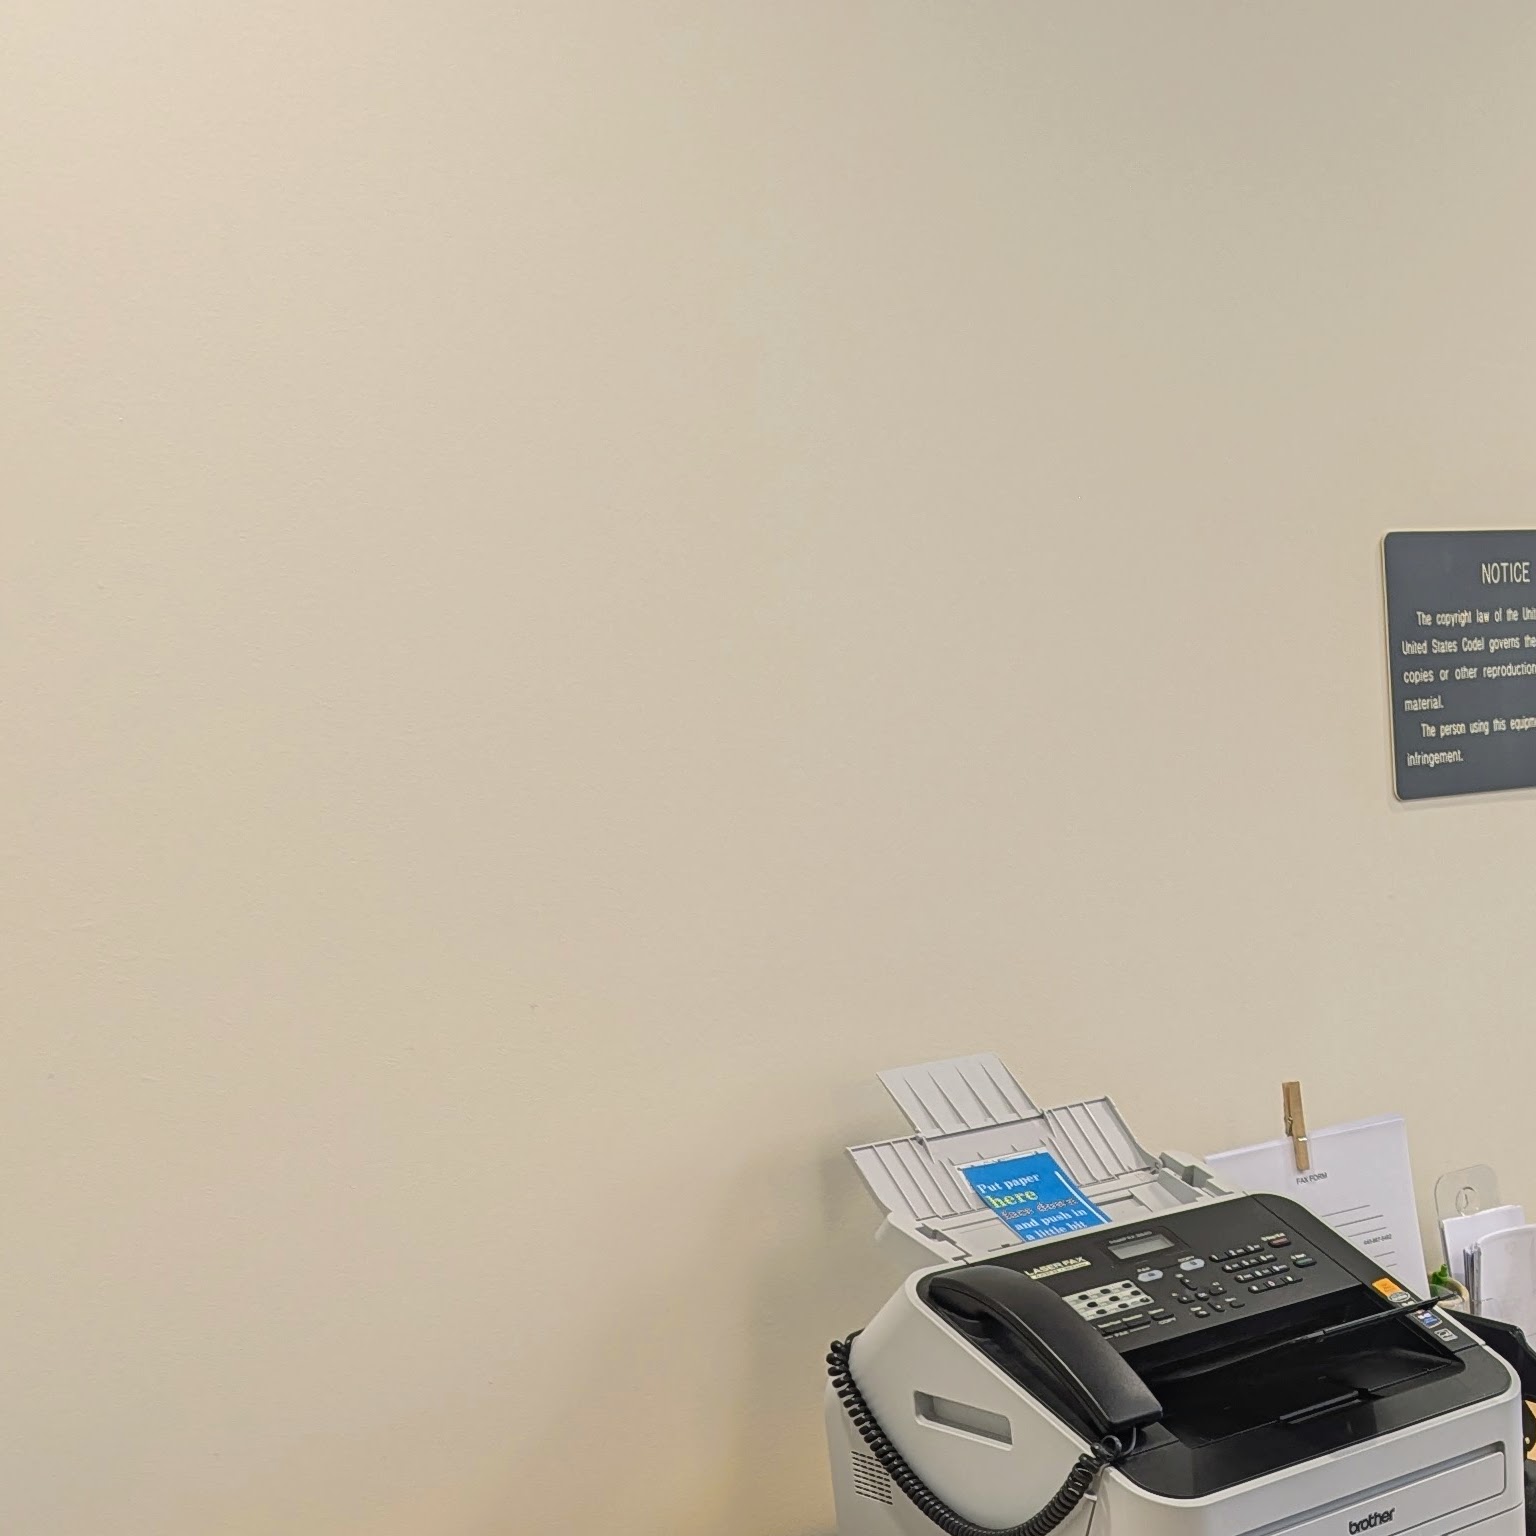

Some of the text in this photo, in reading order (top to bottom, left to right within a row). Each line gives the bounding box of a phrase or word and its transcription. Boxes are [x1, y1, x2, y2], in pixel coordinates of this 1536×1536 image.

[1481, 562, 1530, 584] NOTICE
[1416, 611, 1432, 626] The
[1436, 609, 1472, 627] copyright
[1476, 609, 1489, 623] law
[1494, 608, 1502, 622] of
[1506, 608, 1519, 621] the
[1401, 640, 1428, 655] United
[1431, 638, 1458, 654] States
[1489, 636, 1520, 653] governs
[1524, 635, 1536, 648] the
[1403, 669, 1434, 685] copies
[1439, 668, 1449, 681] or
[1454, 665, 1478, 681] other
[1404, 695, 1444, 712] material.
[1421, 722, 1436, 738] The
[1440, 722, 1466, 738] person
[1470, 719, 1489, 736] using
[1493, 717, 1506, 732] this
[1407, 749, 1464, 767] infringement.
[976, 1173, 1040, 1194] Put paper
[1296, 1172, 1328, 1185] FAX FORM
[985, 1190, 1039, 1208] here
[1014, 1208, 1088, 1231] and push in
[1025, 1234, 1036, 1242] a
[1035, 1225, 1068, 1239] little
[1024, 1262, 1065, 1276] LASER
[1061, 1256, 1086, 1267] FAX
[1349, 1507, 1395, 1535] brother
